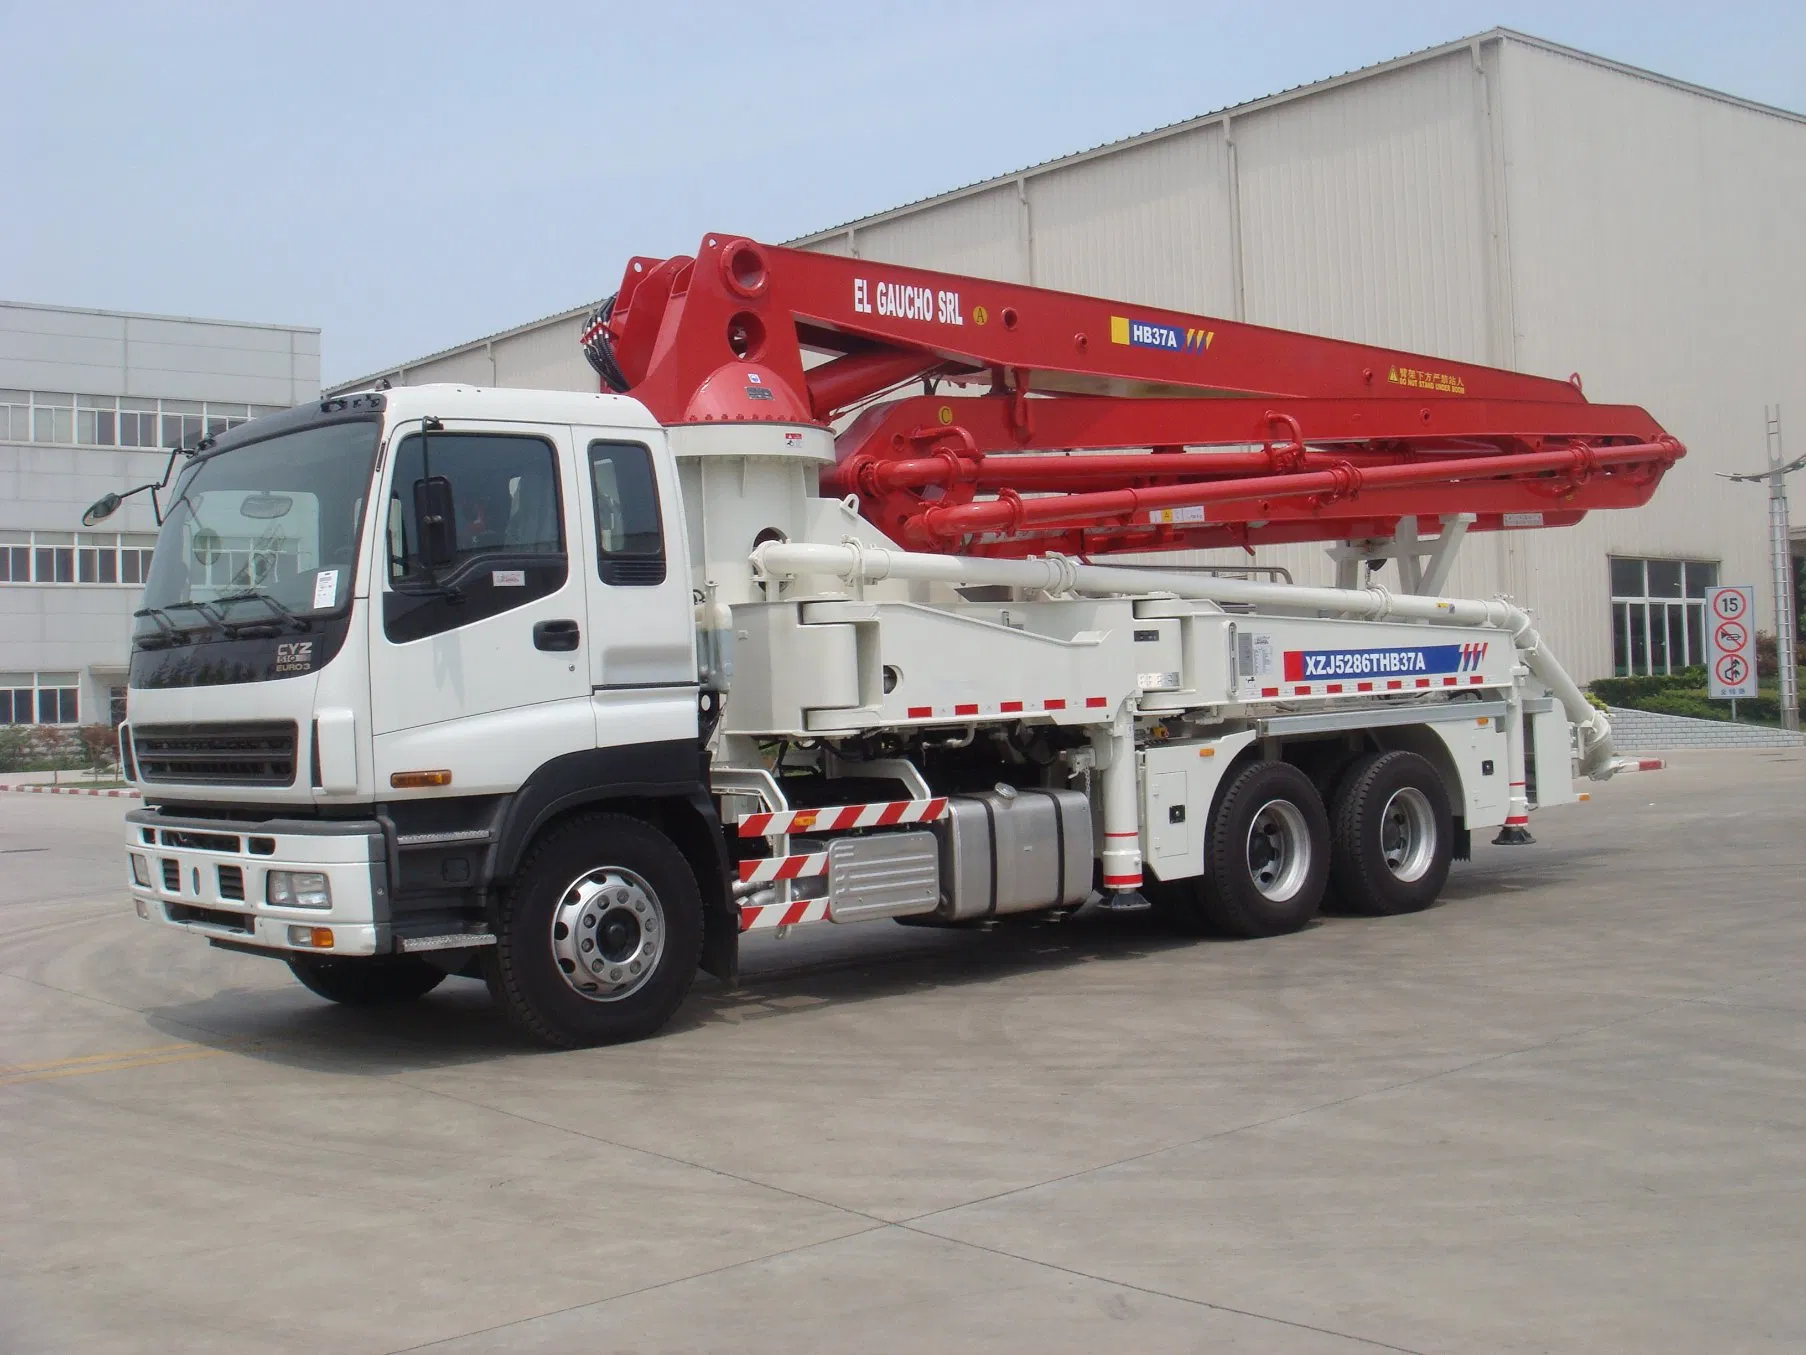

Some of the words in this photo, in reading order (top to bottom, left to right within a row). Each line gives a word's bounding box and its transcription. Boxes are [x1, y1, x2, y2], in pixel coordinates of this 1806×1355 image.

[854, 278, 872, 313] EL
[876, 281, 933, 321] GAUCHO
[938, 290, 964, 325] SRL
[1133, 324, 1177, 348] HB37A
[1418, 381, 1435, 390] STAND
[1722, 597, 1739, 613] 15
[277, 641, 313, 656] CYZ
[1305, 652, 1426, 675] XZJ5286THB37A
